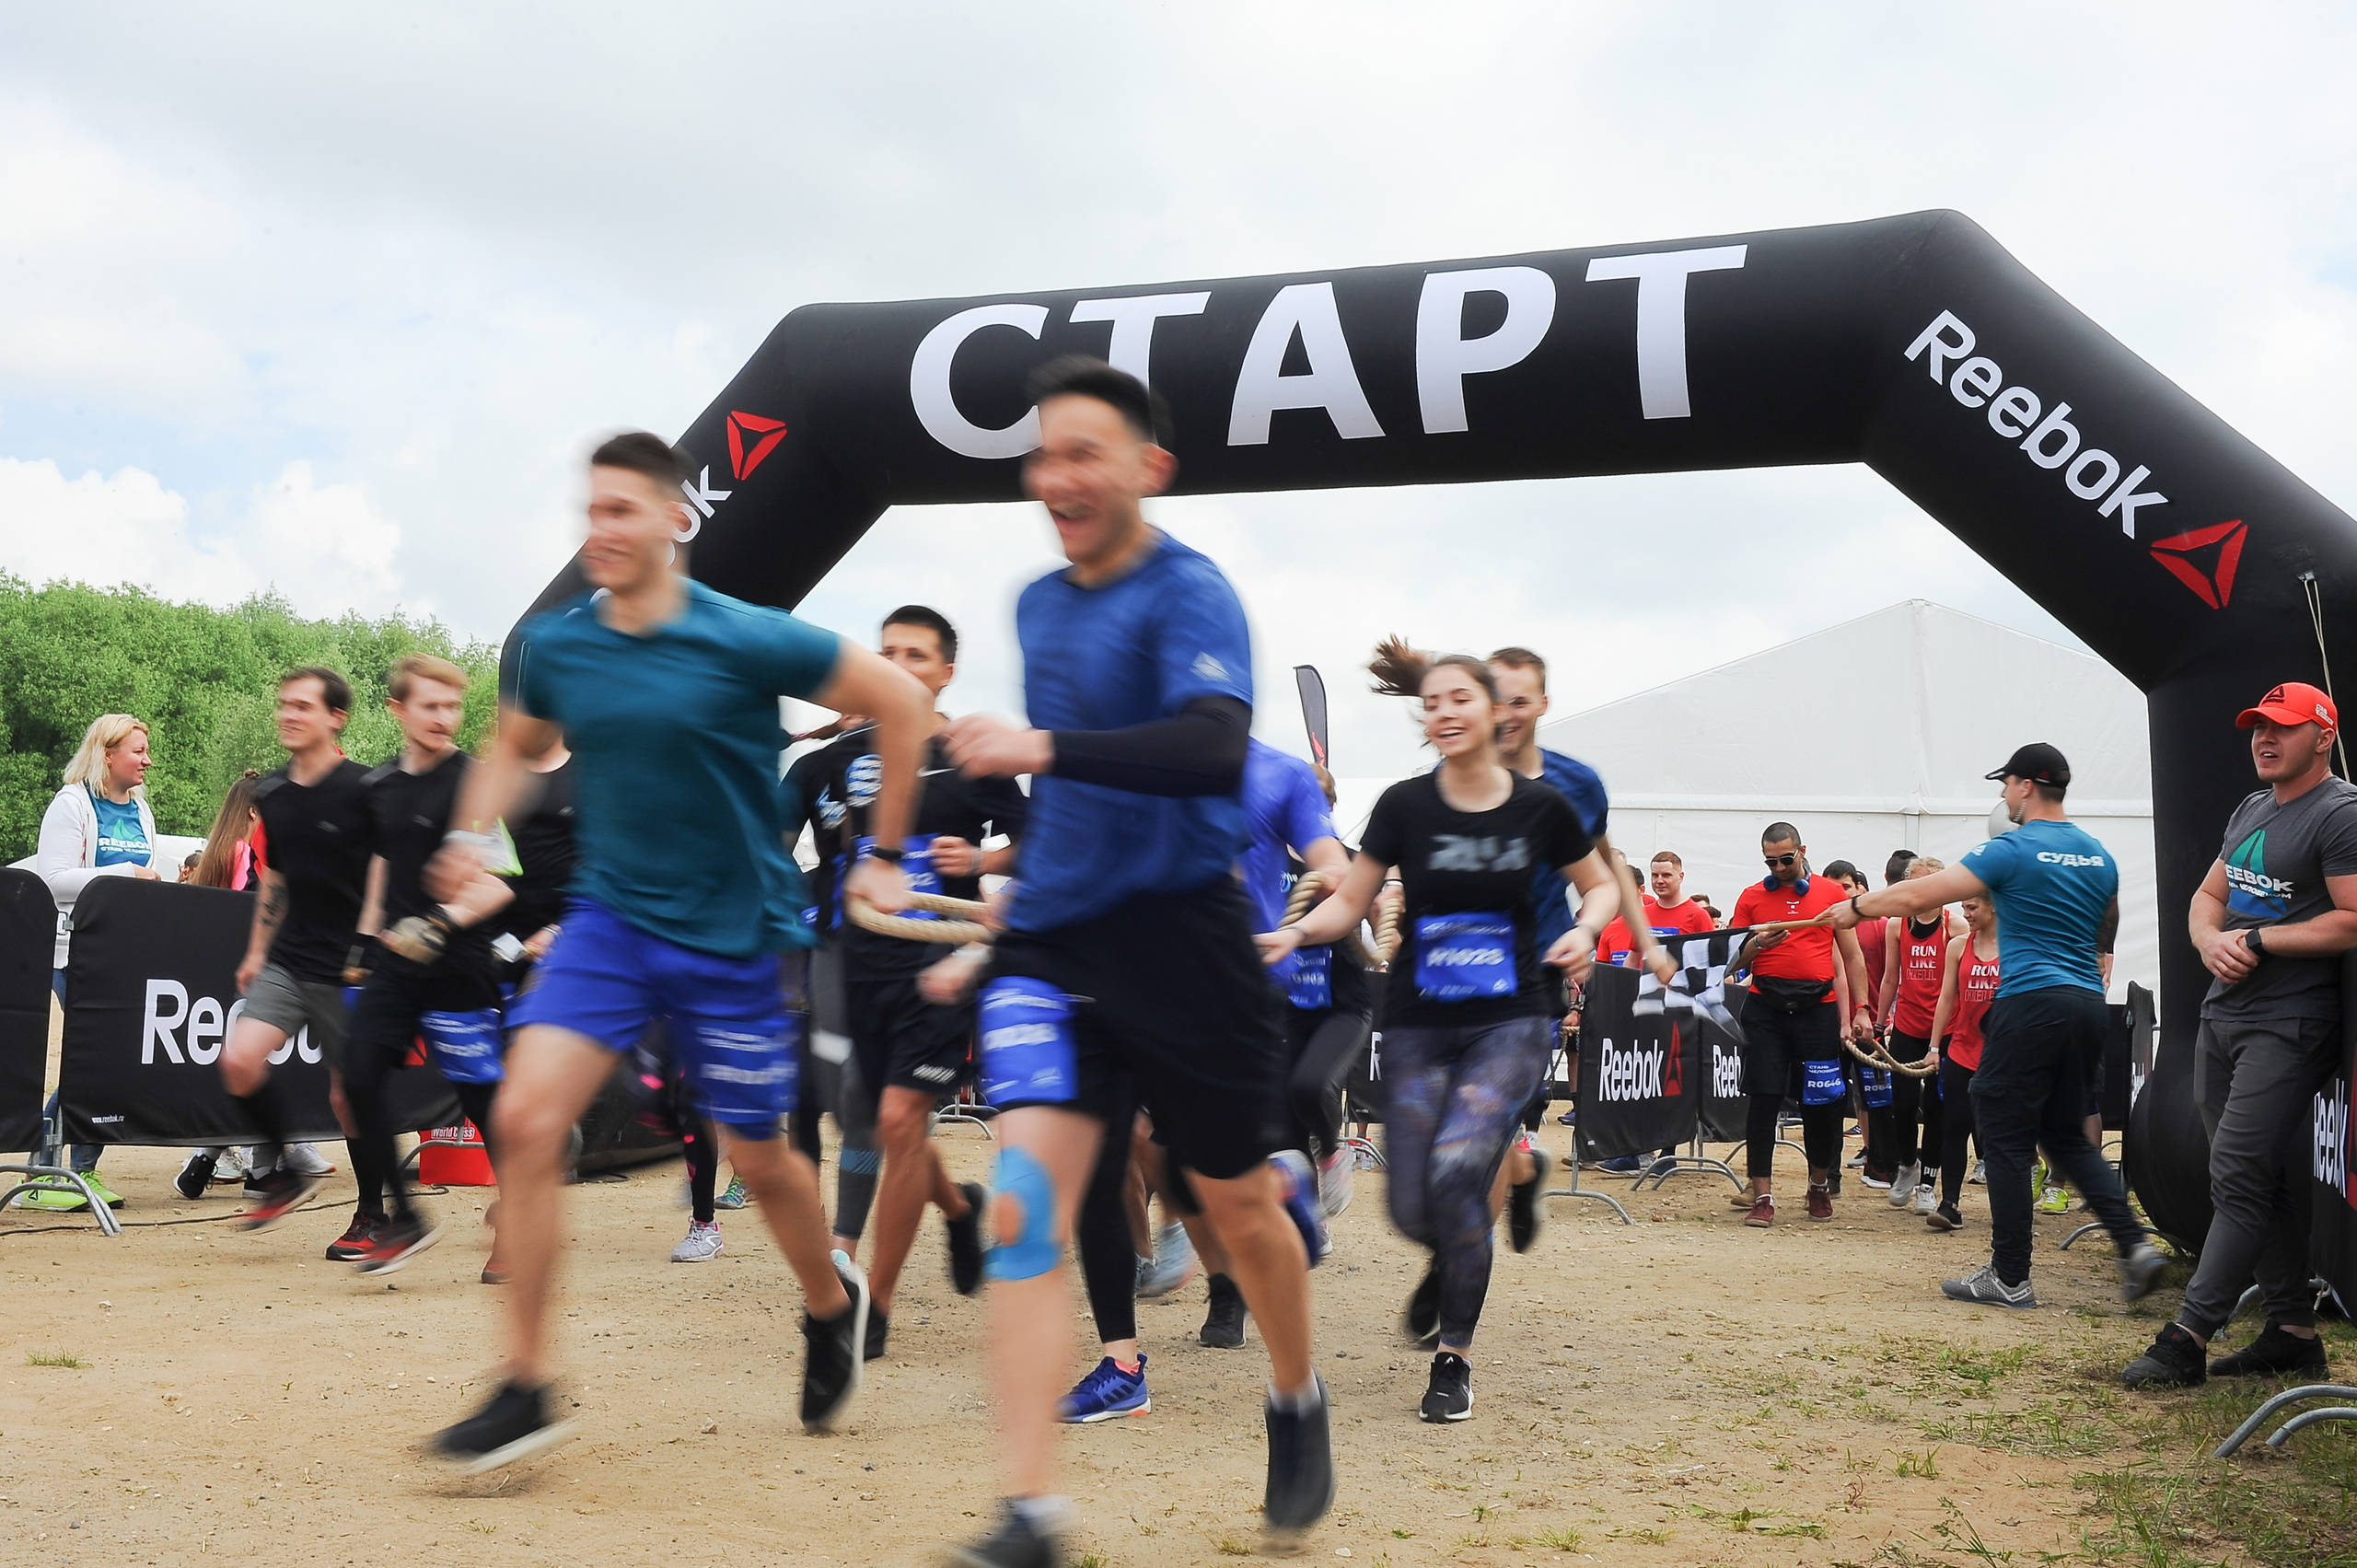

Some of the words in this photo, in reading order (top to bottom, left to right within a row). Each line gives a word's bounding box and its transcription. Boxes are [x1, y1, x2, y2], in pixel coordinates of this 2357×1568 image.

[911, 243, 1748, 459] СТАРТ
[1904, 309, 2168, 540] Reebok
[2037, 852, 2105, 866] СУДЬЯ
[2224, 863, 2294, 892] EEBOK
[1911, 946, 1937, 957] RUN
[1910, 959, 1936, 969] LIKE
[1970, 964, 2000, 976] RUN
[1906, 970, 1937, 981] HELL
[1968, 979, 1999, 989] LIKE
[1598, 1038, 1665, 1102] Reebok
[1713, 1044, 1747, 1098] Reeb
[1807, 1078, 1841, 1088] R0646
[433, 1128, 452, 1138] World
[452, 1128, 474, 1138] Css
[1924, 1166, 1937, 1178] PU
